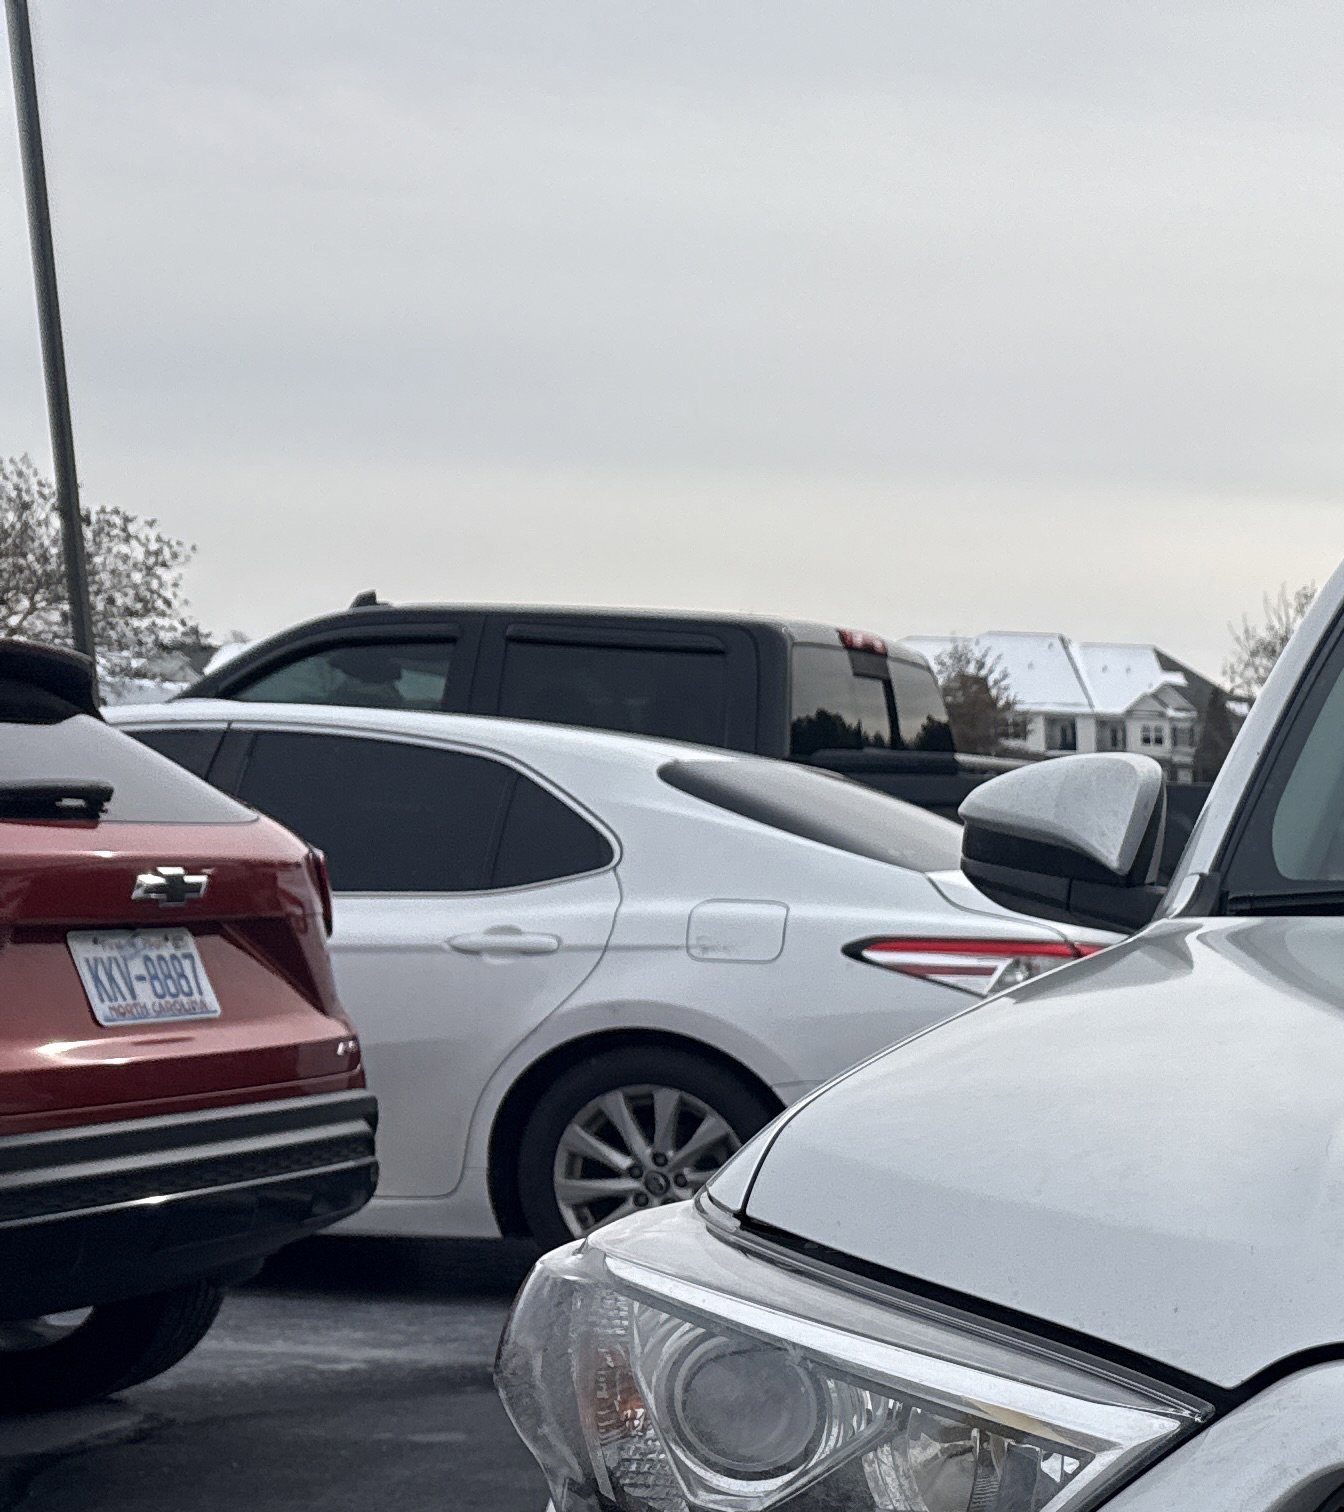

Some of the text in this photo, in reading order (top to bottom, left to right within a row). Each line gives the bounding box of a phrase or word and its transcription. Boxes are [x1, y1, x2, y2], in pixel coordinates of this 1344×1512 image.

[85, 953, 203, 1002] KKV-8887
[108, 999, 209, 1018] NORTH CAROLINA
